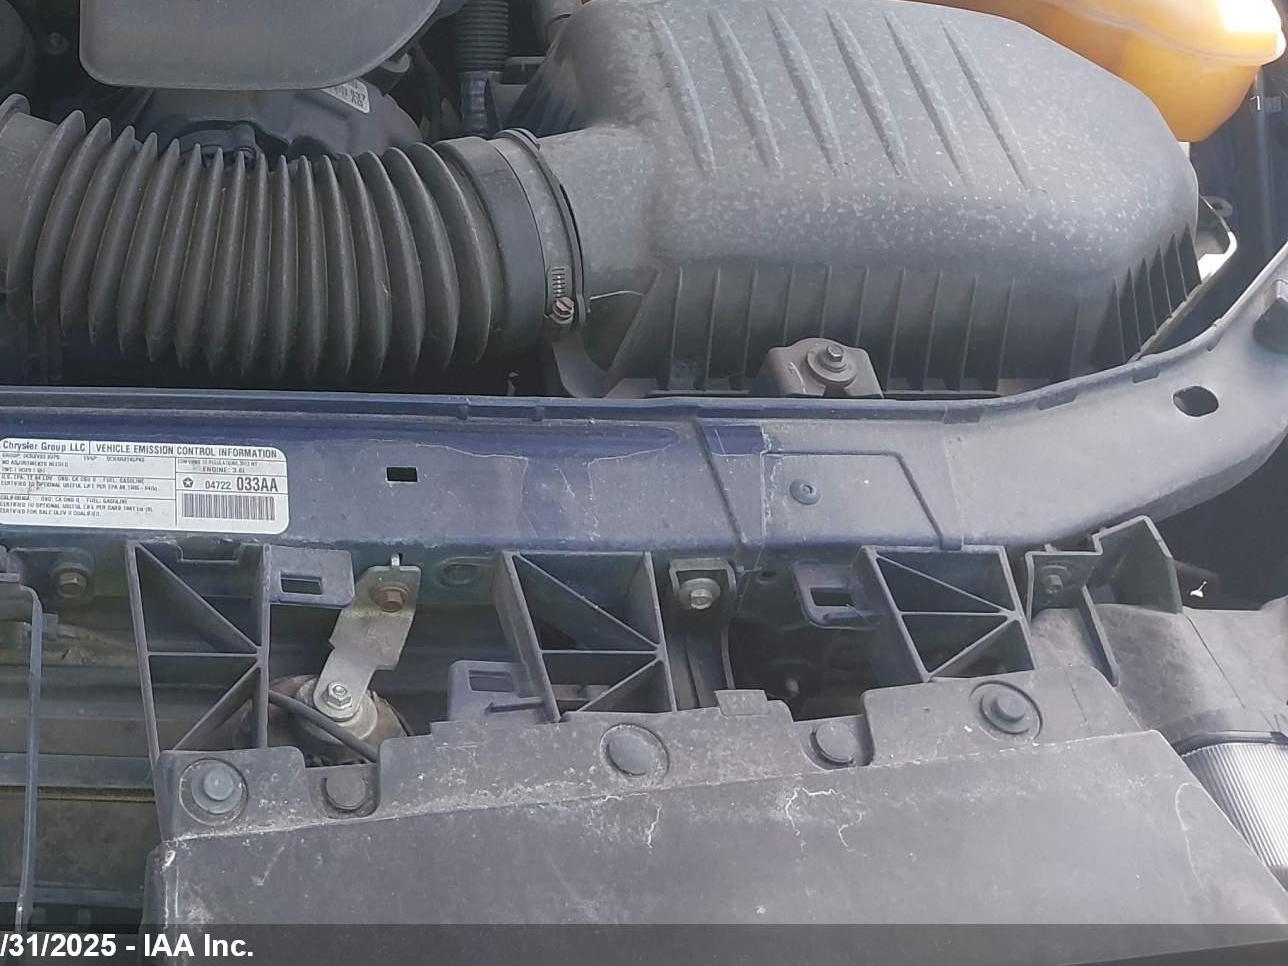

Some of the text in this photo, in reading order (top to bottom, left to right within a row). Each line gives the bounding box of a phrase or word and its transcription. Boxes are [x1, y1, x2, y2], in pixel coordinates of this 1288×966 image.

[2, 440, 86, 454] Chrysler Group LLC
[95, 443, 278, 459] VEHICLE EMISSION CONTROL INFORMATION
[205, 476, 278, 492] 04722 033AA
